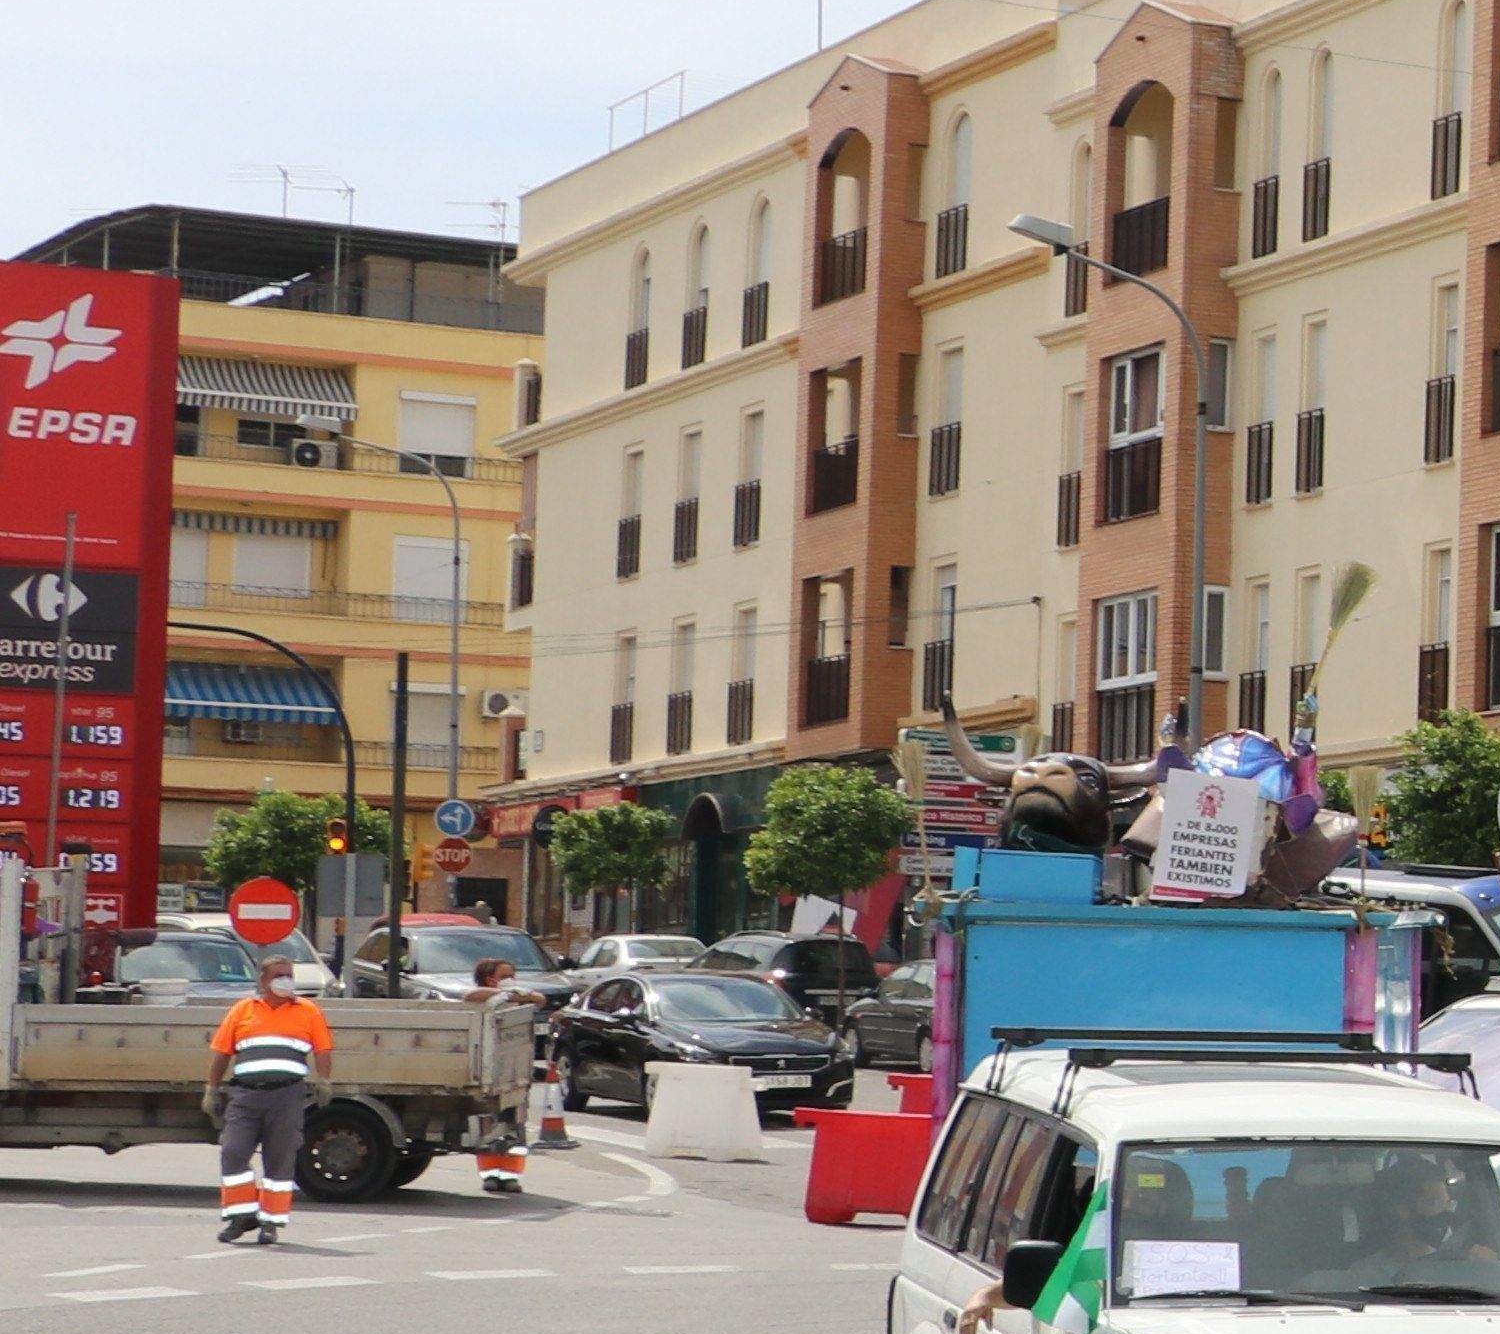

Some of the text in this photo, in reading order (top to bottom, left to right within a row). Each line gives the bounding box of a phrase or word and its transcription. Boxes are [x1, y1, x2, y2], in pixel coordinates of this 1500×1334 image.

[1173, 831, 1237, 849] EMPRESAS
[434, 848, 471, 864] STOP
[1170, 845, 1236, 863] FERIANTES
[1169, 857, 1233, 876] TAMBIEN
[1167, 871, 1232, 888] EXISTIMOS
